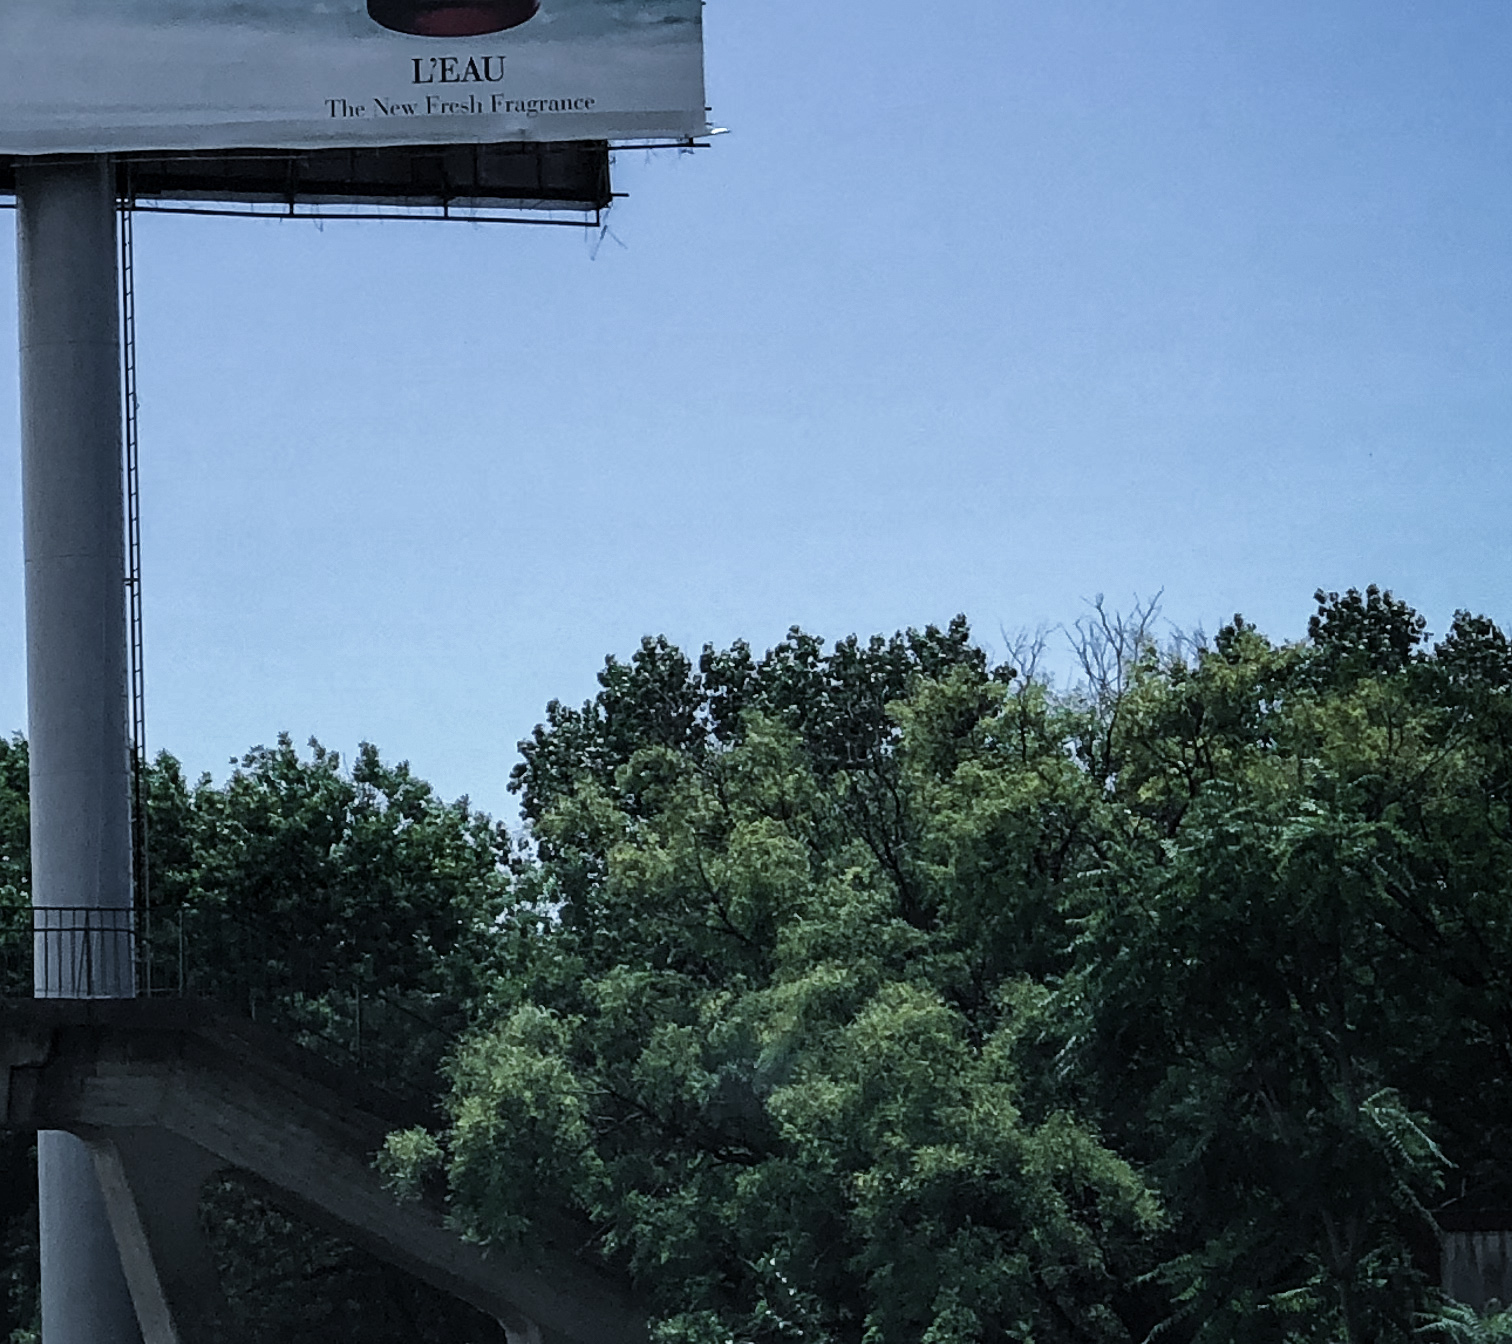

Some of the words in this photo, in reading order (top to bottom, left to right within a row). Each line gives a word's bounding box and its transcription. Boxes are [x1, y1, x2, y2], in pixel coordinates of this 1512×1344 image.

[411, 56, 506, 84] L'EAU
[325, 98, 366, 118] The
[373, 97, 418, 117] New
[425, 94, 483, 115] Fresh
[490, 93, 596, 118] Fragrance
